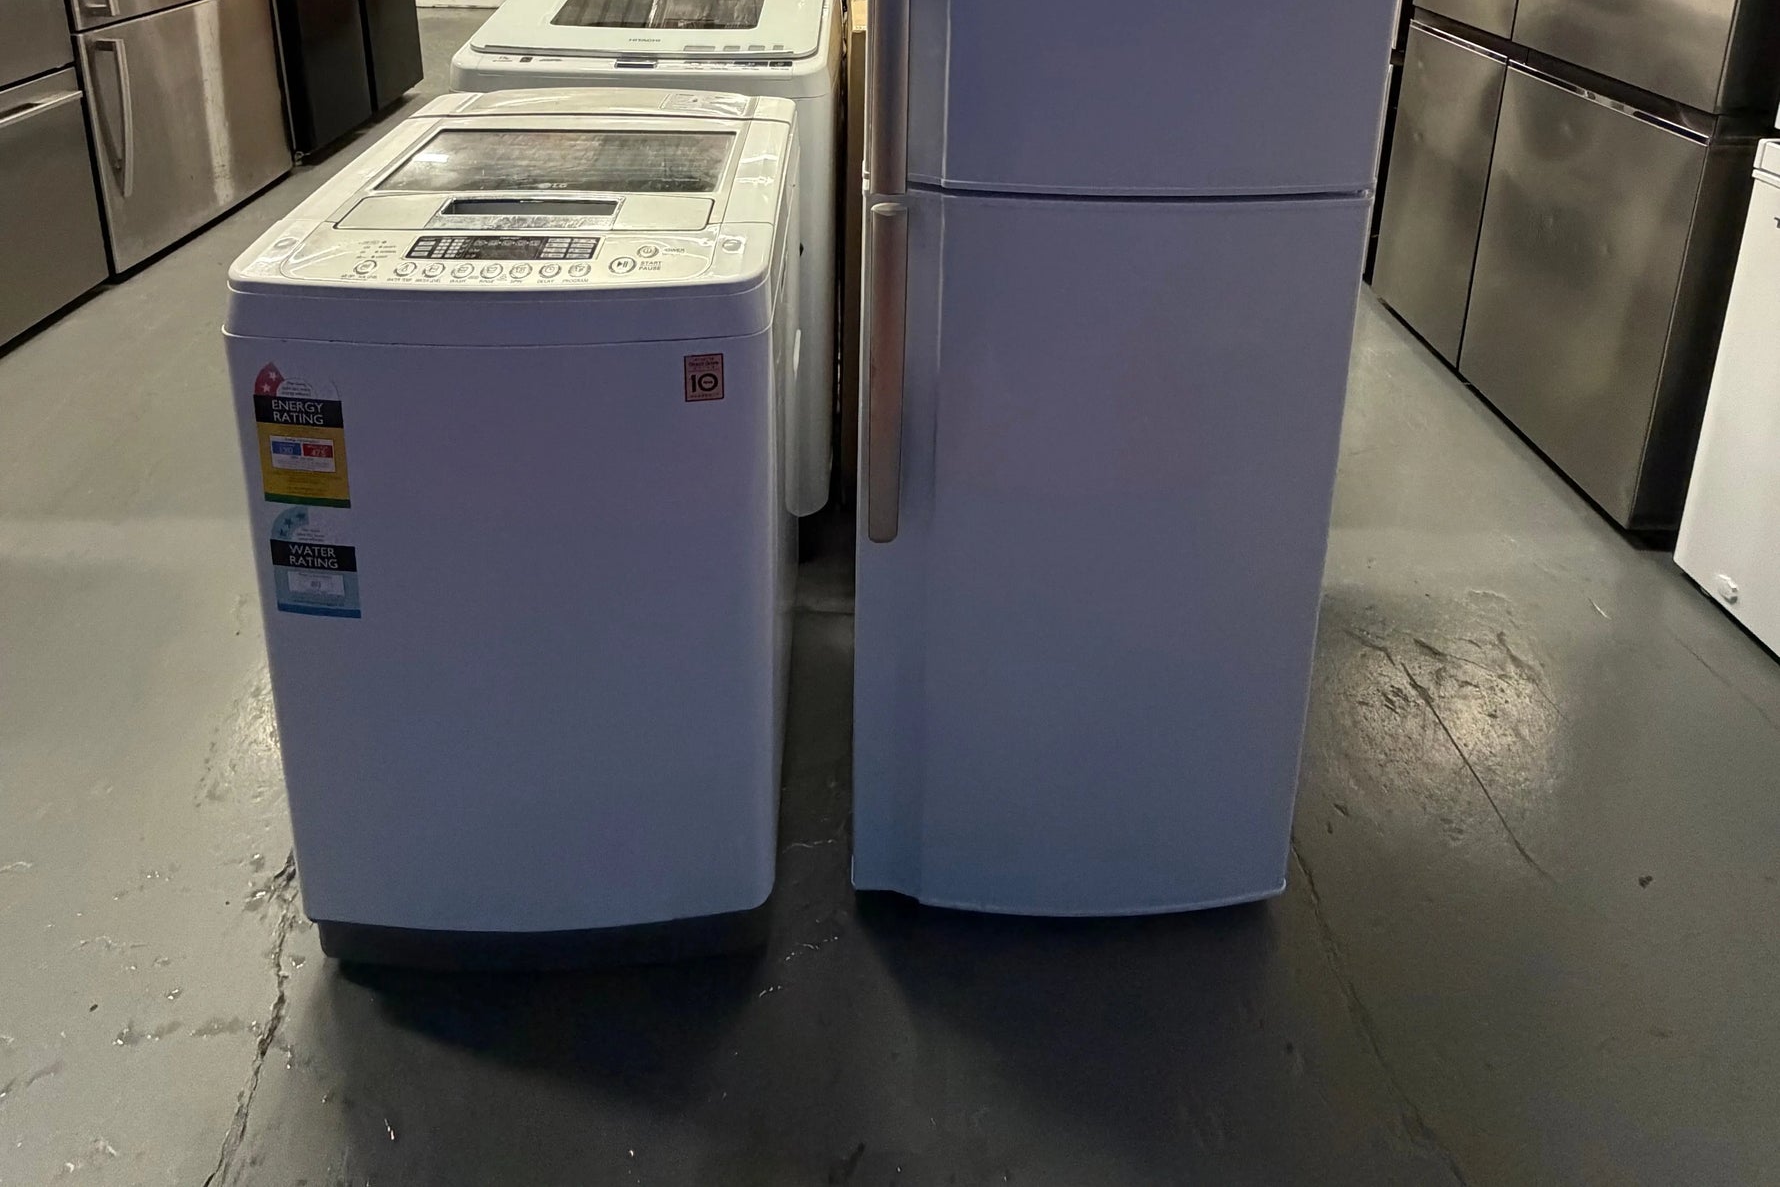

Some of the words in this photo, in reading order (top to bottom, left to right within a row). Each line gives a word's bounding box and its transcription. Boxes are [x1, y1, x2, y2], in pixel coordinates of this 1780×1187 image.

[271, 399, 324, 413] ENERGY
[273, 411, 324, 425] RATING
[288, 544, 336, 558] WATER
[289, 555, 339, 569] RATING
